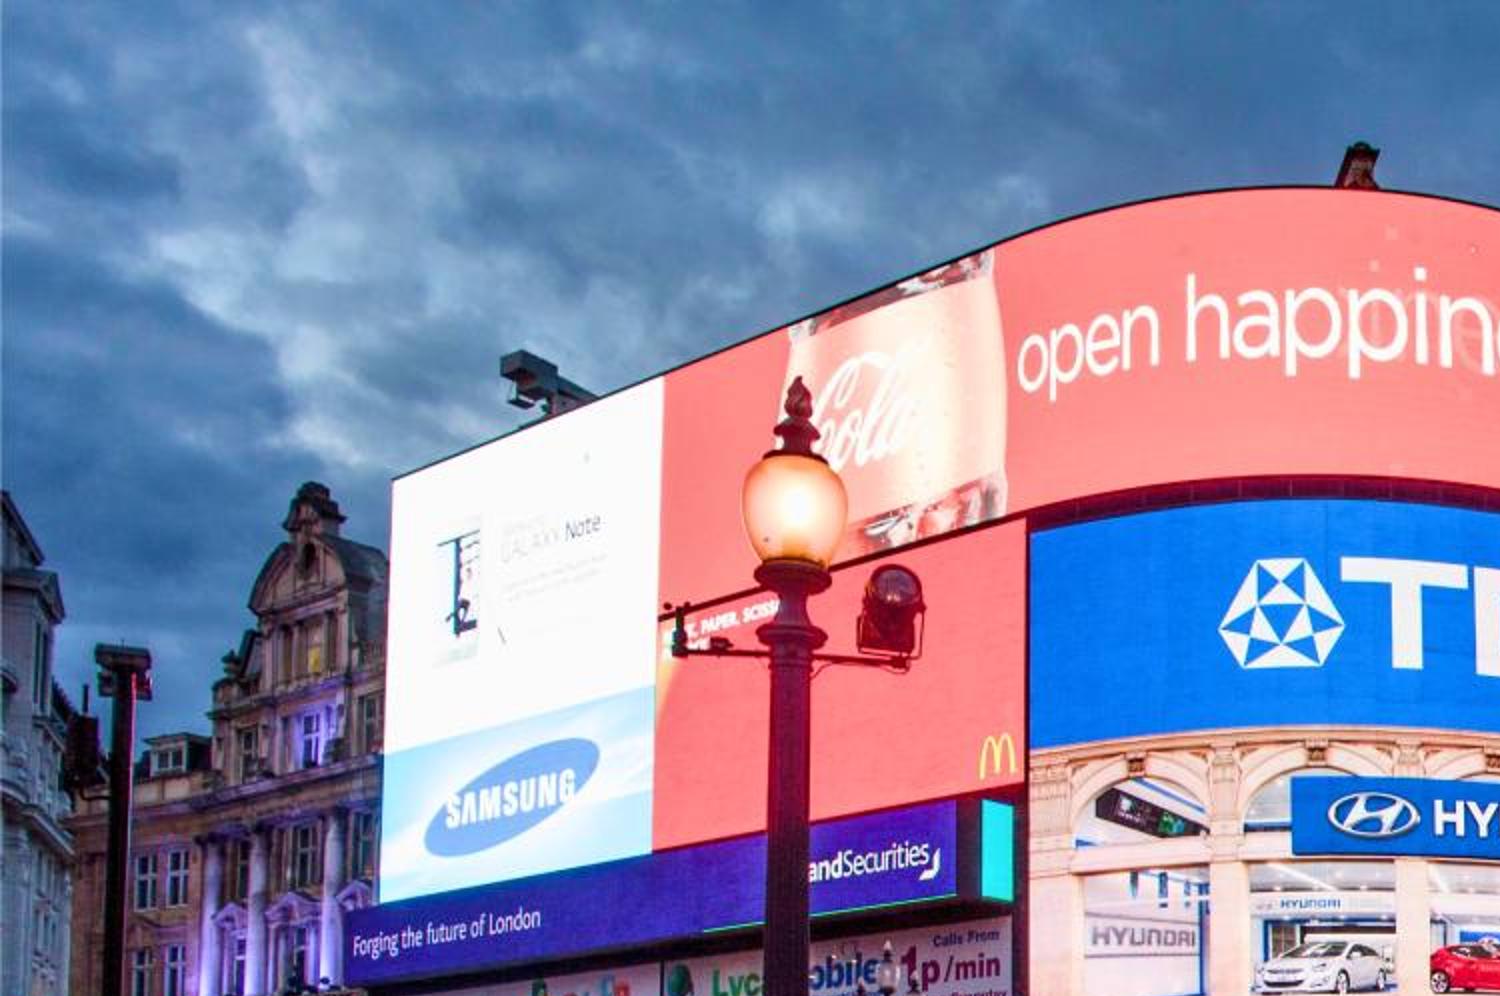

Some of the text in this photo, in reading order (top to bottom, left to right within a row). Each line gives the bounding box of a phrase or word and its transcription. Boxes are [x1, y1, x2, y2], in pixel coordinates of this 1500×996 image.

[1017, 304, 1160, 401] open
[563, 516, 602, 542] Note
[445, 767, 577, 829] SAMSUNG
[809, 841, 931, 882] andSecurities
[354, 906, 542, 960] Forging the future of London
[1092, 926, 1196, 947] HYUNDAI
